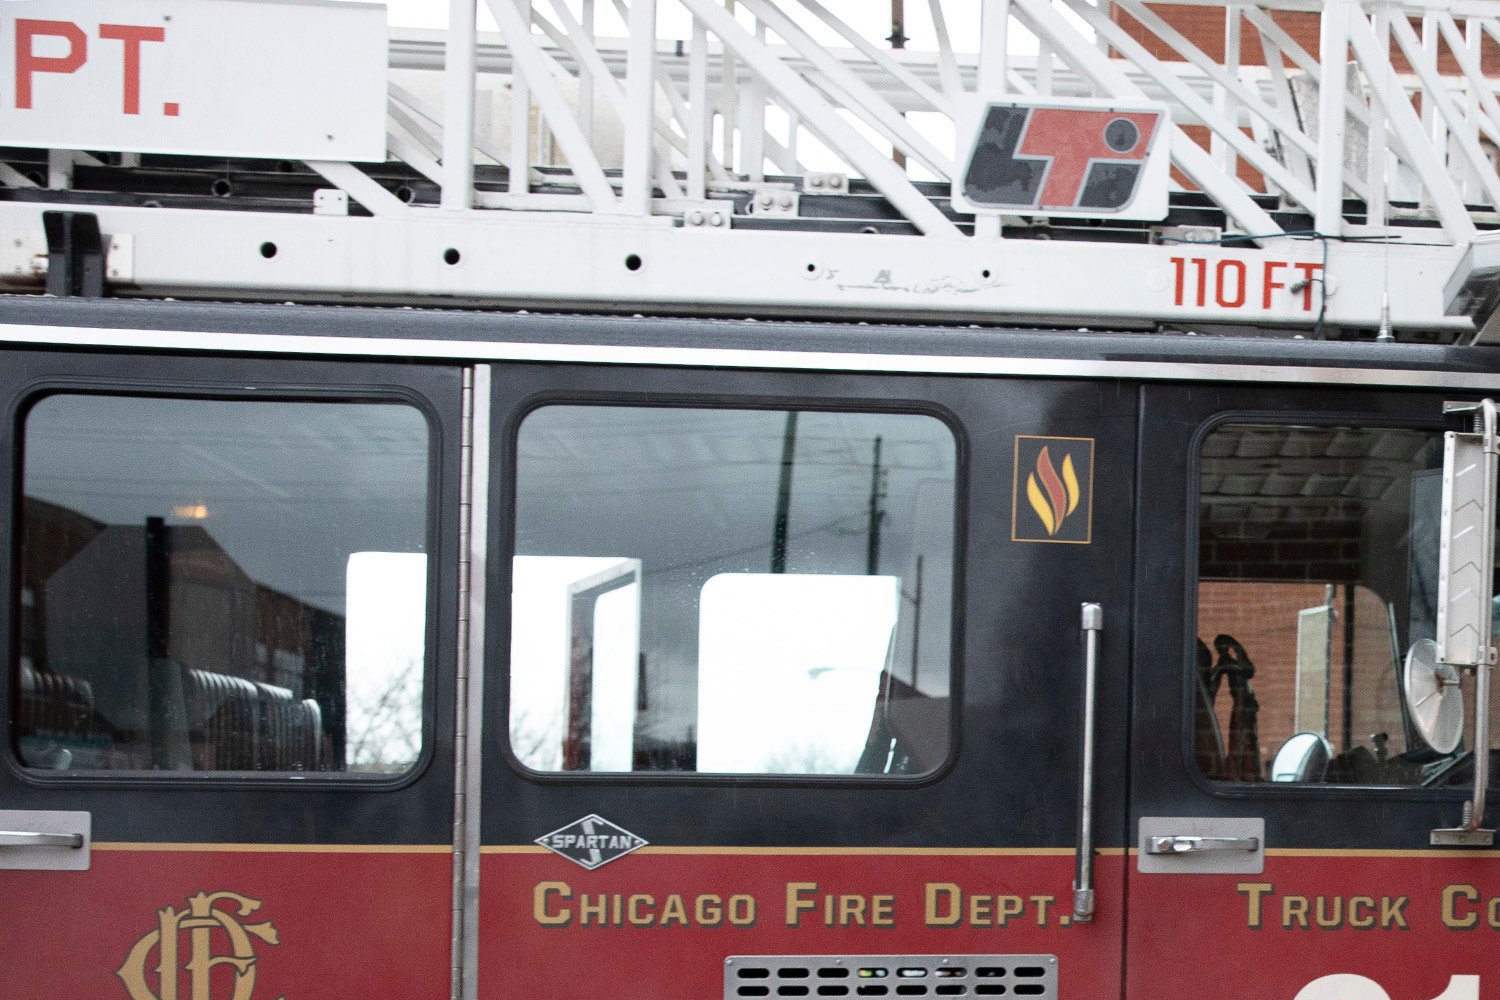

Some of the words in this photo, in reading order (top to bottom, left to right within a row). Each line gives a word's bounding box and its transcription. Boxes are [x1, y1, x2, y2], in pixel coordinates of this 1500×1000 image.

[1170, 257, 1246, 308] 110
[552, 834, 632, 849] SPARTAN
[533, 881, 758, 929] CHICAGO
[786, 882, 896, 928] FIRE
[924, 882, 1073, 928] DEPT.
[1236, 883, 1410, 931] TRUCK
